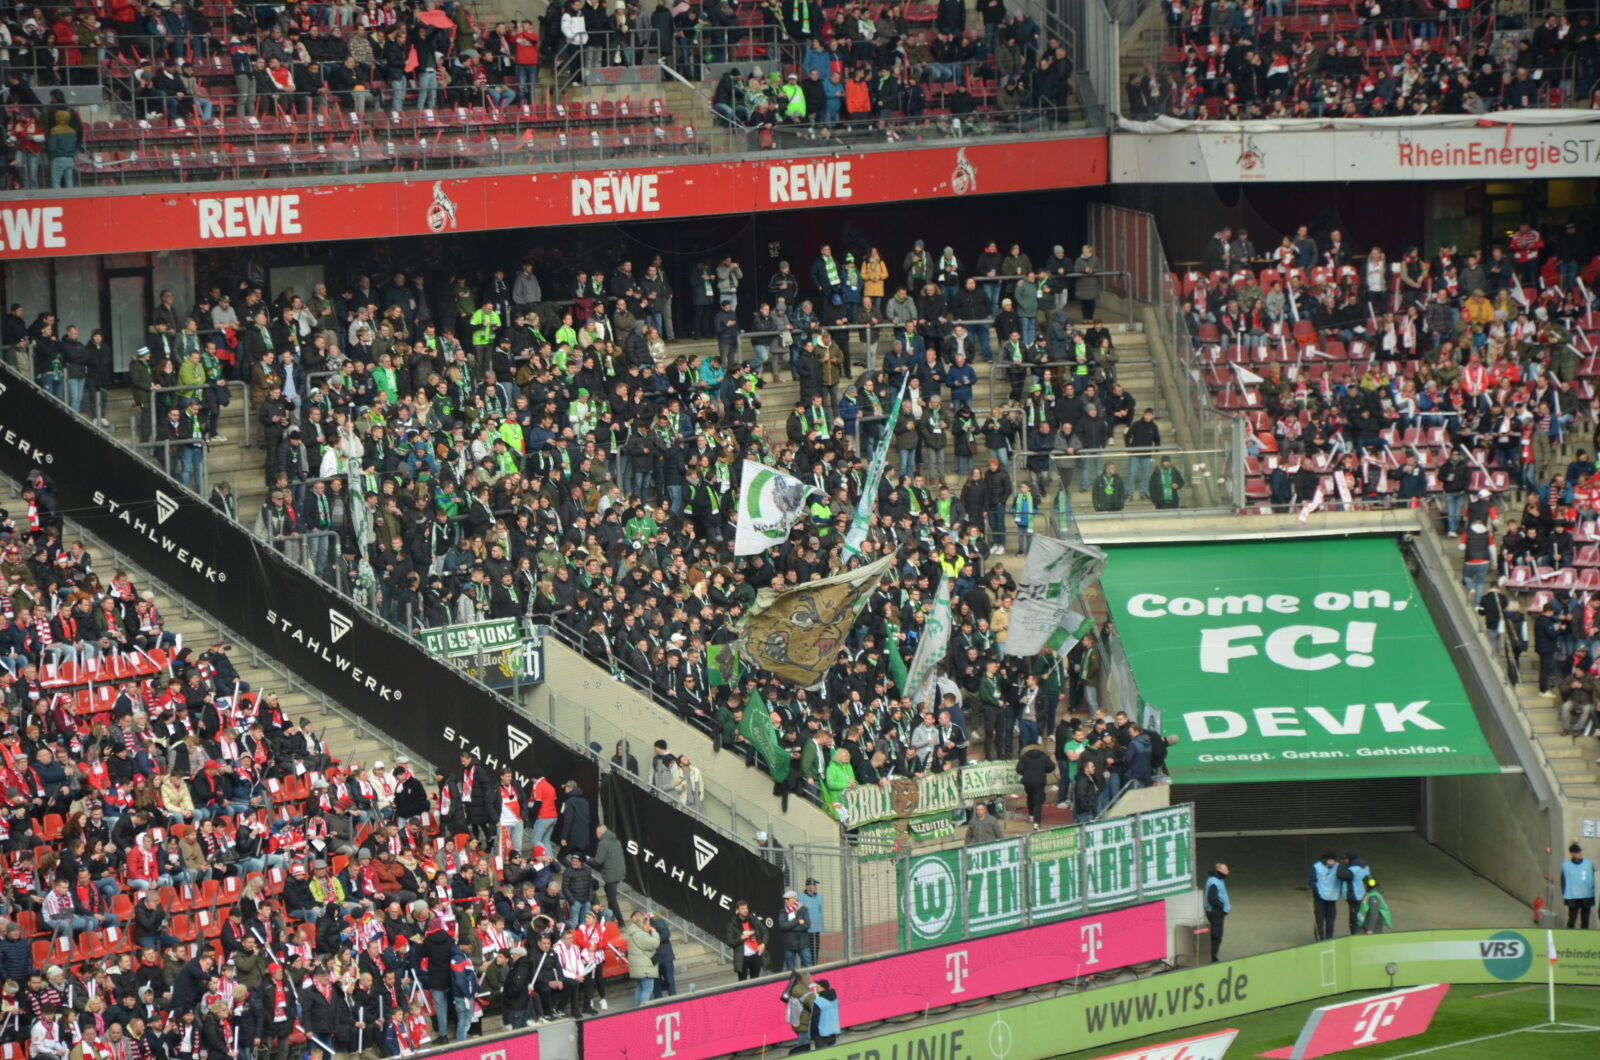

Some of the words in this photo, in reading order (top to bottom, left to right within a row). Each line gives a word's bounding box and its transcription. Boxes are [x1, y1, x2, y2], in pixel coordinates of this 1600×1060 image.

[571, 174, 660, 216] REWE
[769, 161, 852, 203] REWE
[0, 206, 66, 250] WE
[199, 194, 302, 239] REWE
[1126, 592, 1300, 619] Come
[1312, 589, 1409, 612] on,
[1199, 620, 1378, 674] FC!
[1182, 700, 1447, 742] DEVK
[1198, 753, 1276, 763] Gesagt.
[1281, 750, 1351, 761] Getan.
[1355, 745, 1458, 757] Geholfen.
[1479, 941, 1520, 958] VRS
[1085, 965, 1249, 1034] www.vrs.de
